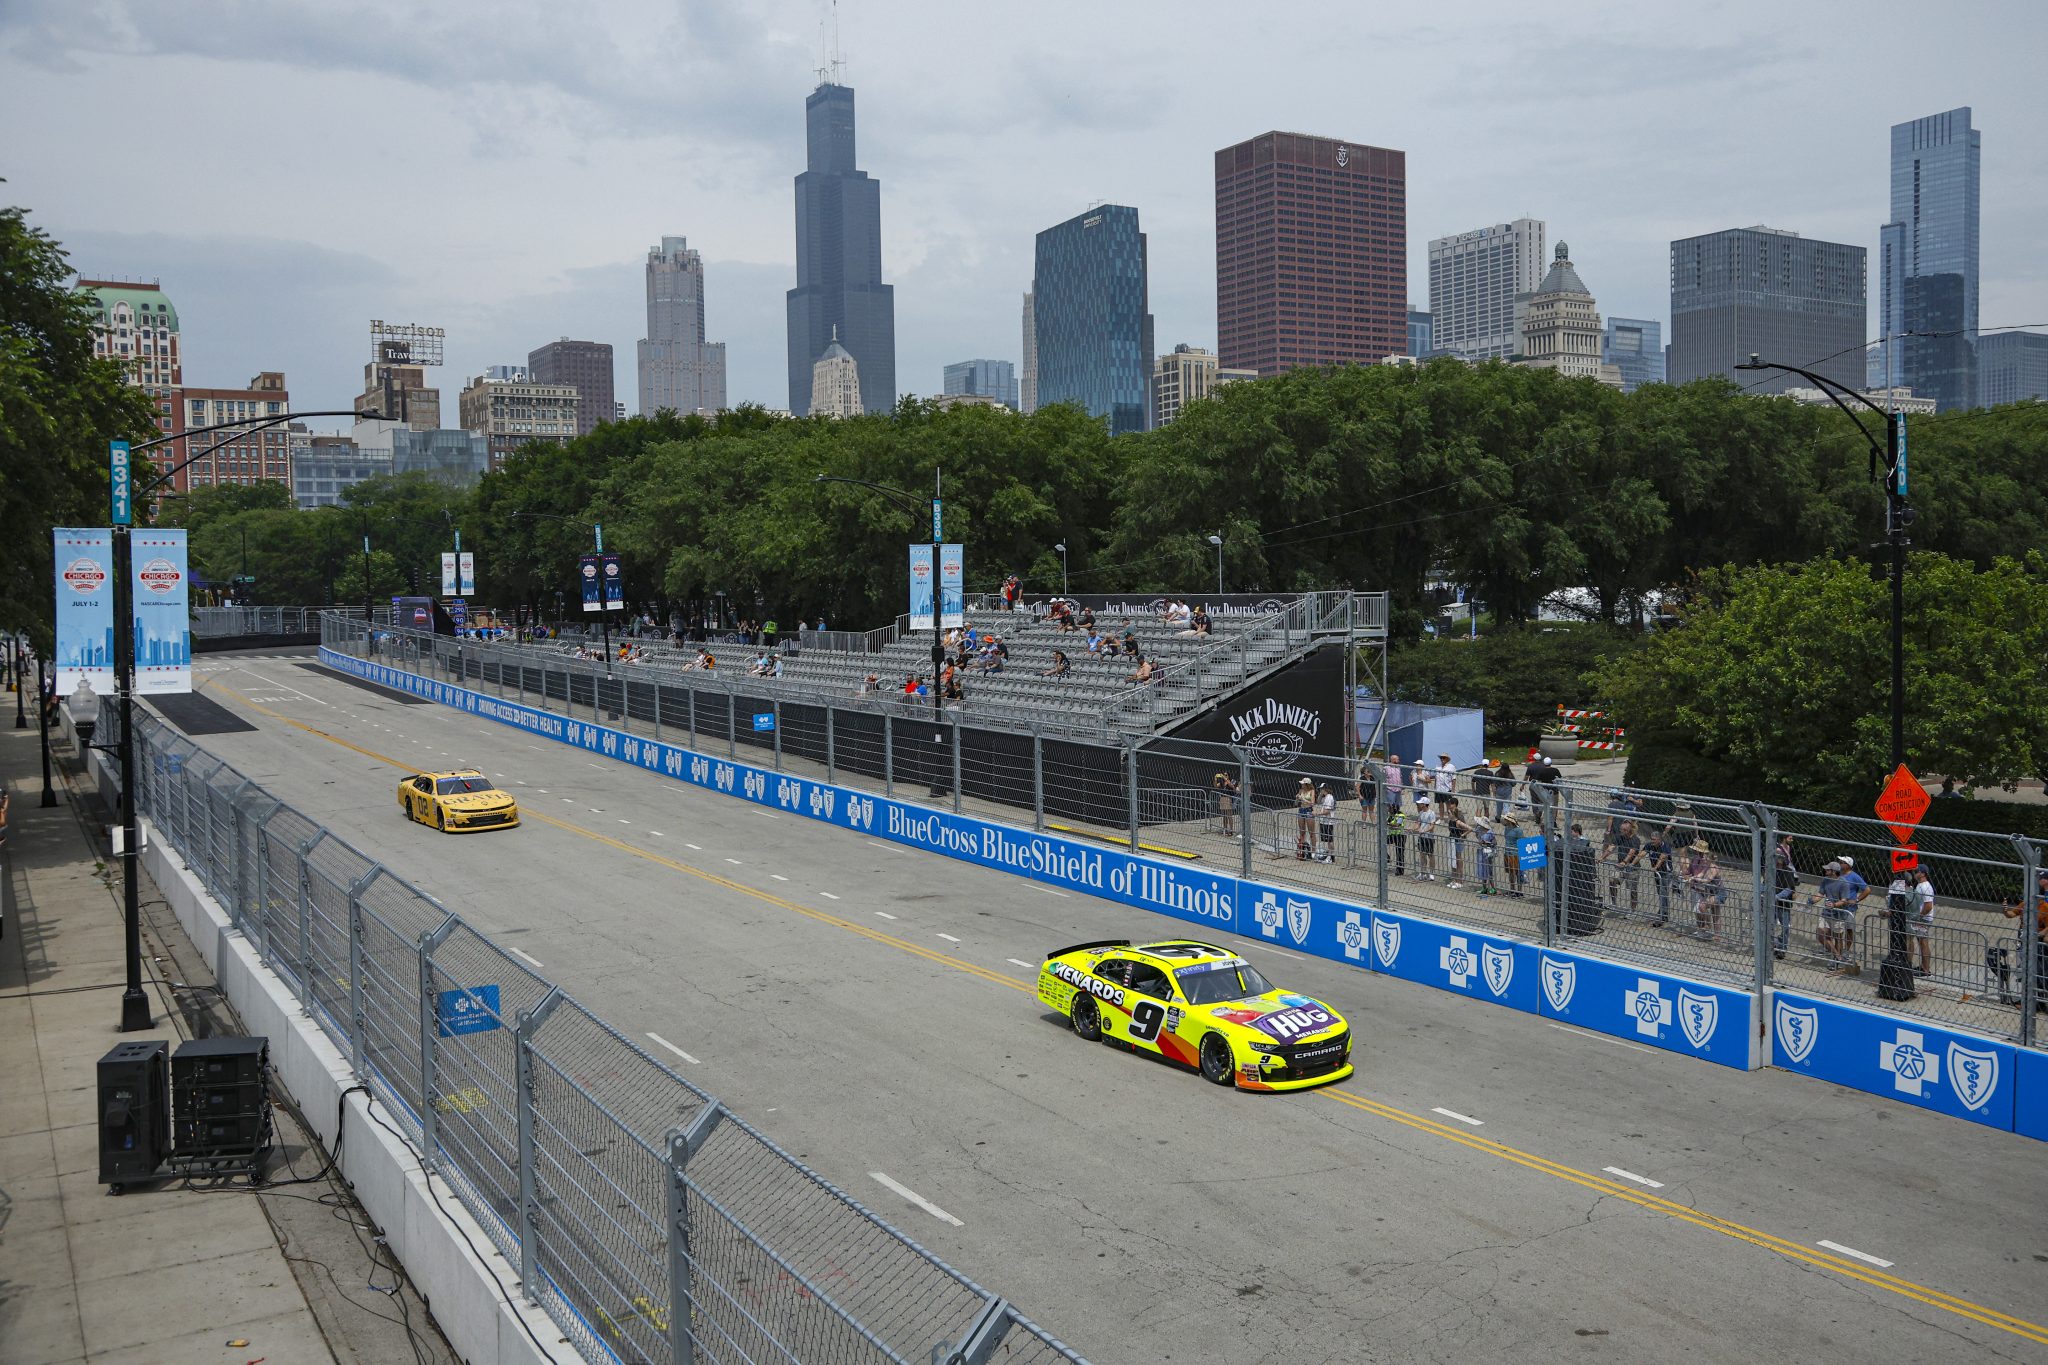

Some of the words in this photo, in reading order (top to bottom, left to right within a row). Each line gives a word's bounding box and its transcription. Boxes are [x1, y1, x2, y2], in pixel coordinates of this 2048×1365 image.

[370, 319, 445, 337] Harrison
[112, 449, 128, 516] B341
[478, 699, 496, 716] DRIVING
[496, 704, 513, 721] ACCESS
[520, 711, 539, 729] BETTER
[539, 716, 562, 736] HEALTH
[1229, 705, 1266, 742] JACK
[1265, 697, 1322, 737] DANIEL'S
[1879, 798, 1926, 813] CONSTRUCTION
[1895, 788, 1912, 799] ROAD
[1894, 810, 1916, 821] AHEAD
[888, 805, 978, 856] BlueCross
[981, 827, 1103, 889] BlueShield
[1110, 862, 1137, 895] of
[1139, 865, 1233, 921] Illinois
[1055, 961, 1125, 1006] MENARDS
[1129, 1000, 1165, 1042] 9
[1266, 1009, 1329, 1039] HUG
[1260, 1055, 1270, 1063] 9
[1294, 1045, 1342, 1059] CAMARO
